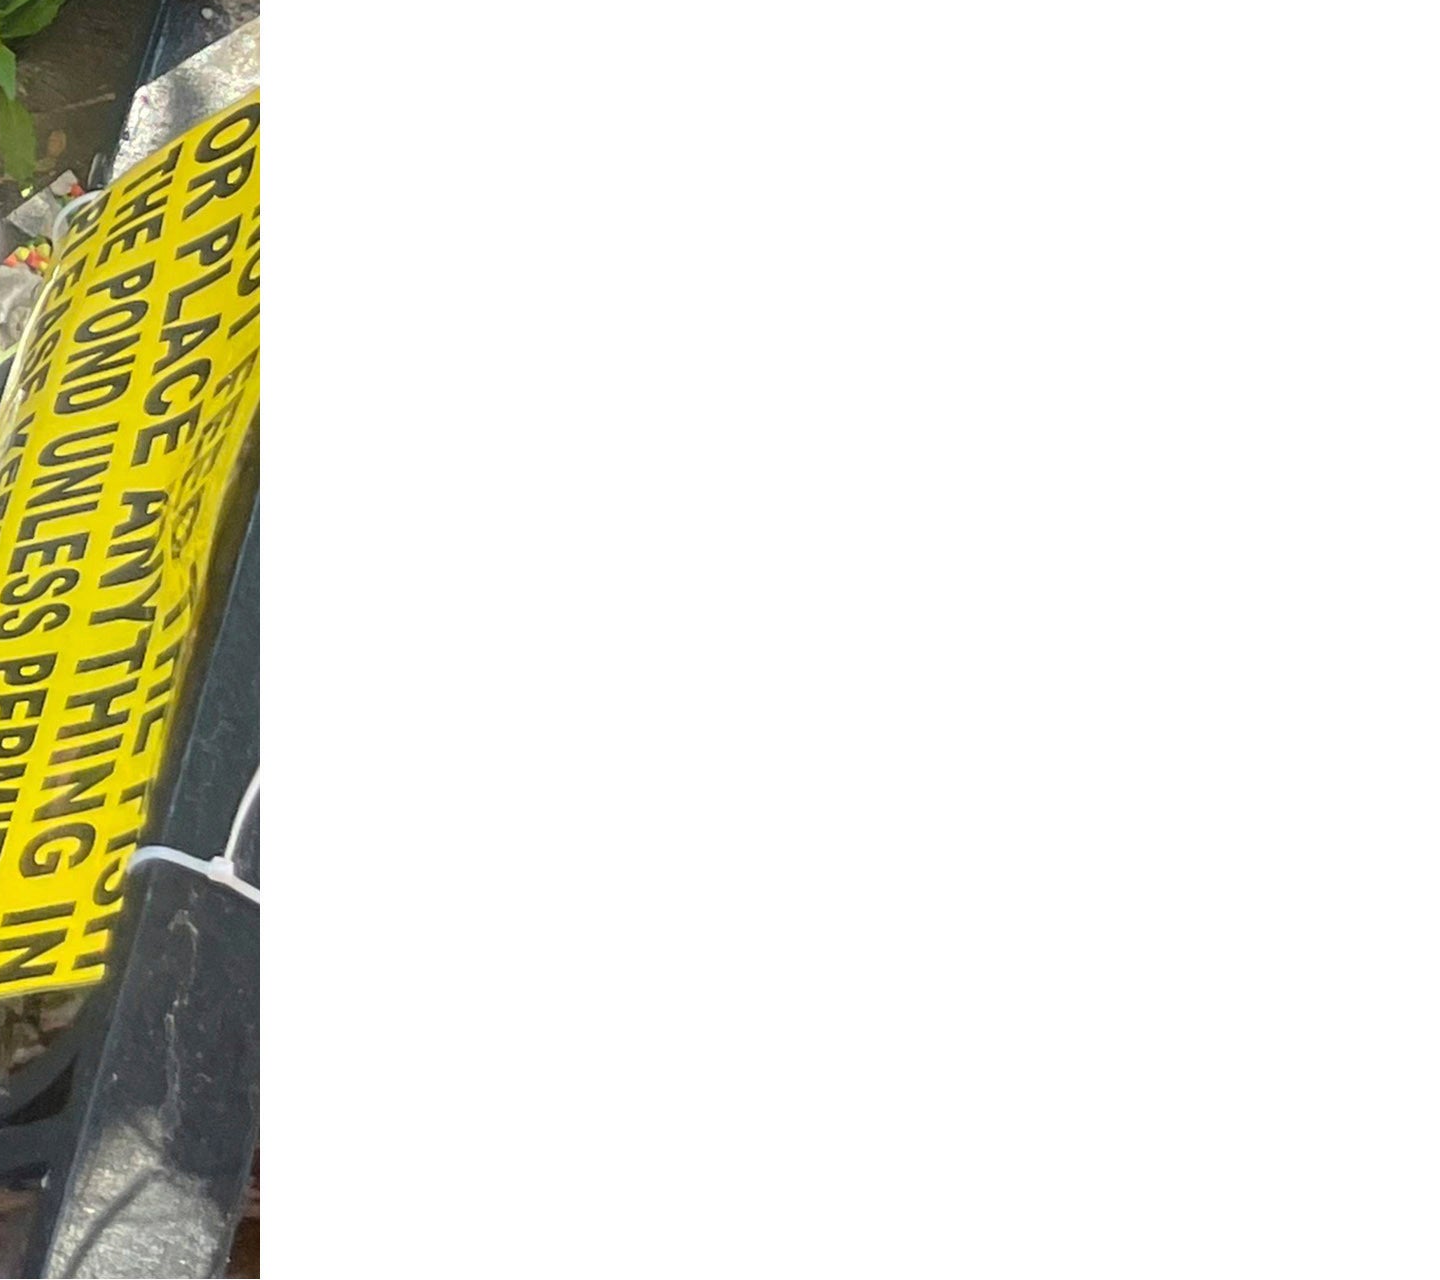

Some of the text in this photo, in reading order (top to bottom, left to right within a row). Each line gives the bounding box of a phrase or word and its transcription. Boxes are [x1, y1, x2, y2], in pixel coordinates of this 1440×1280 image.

[95, 142, 184, 268] THE
[181, 102, 260, 221] OR
[53, 260, 156, 416] POND
[131, 214, 242, 468] PLACE
[18, 490, 170, 879] ANYTHING
